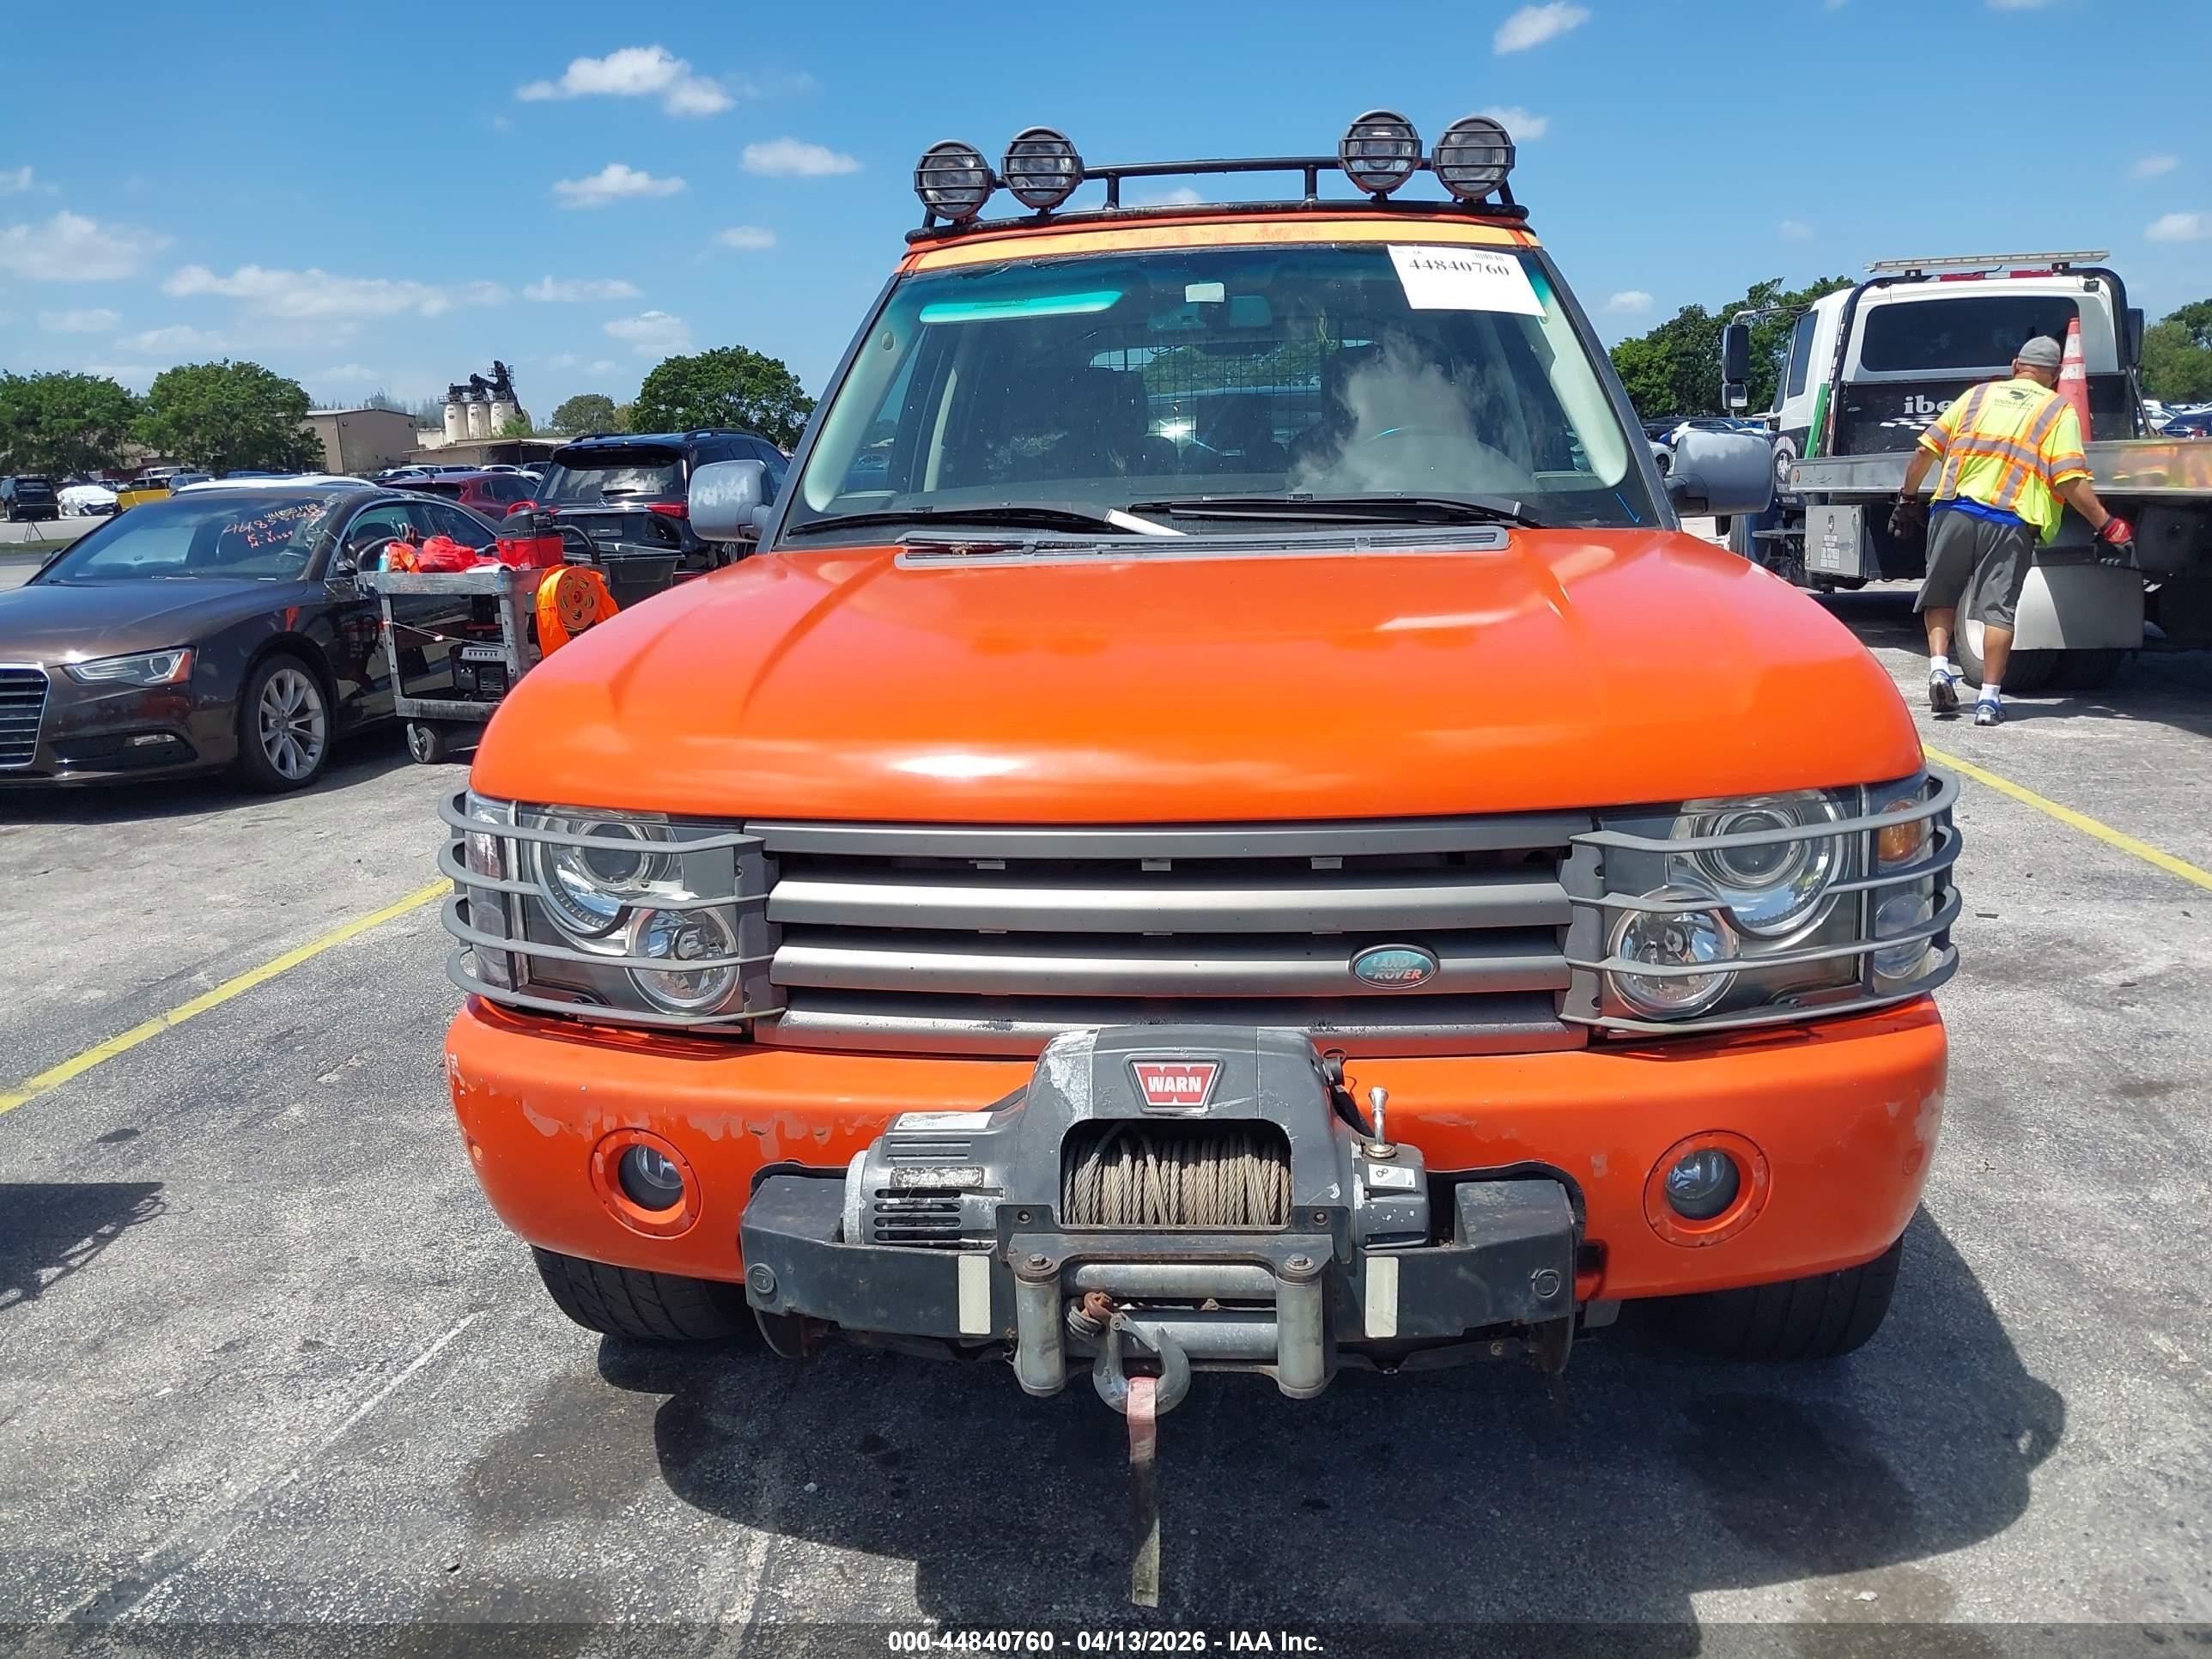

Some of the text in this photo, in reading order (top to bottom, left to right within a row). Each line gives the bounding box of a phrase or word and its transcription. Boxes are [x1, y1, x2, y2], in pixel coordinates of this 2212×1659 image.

[1409, 258, 1510, 276] 44840760
[1373, 955, 1413, 969] LAND
[1373, 969, 1423, 980] ROVER
[1147, 1076, 1202, 1093] WARN
